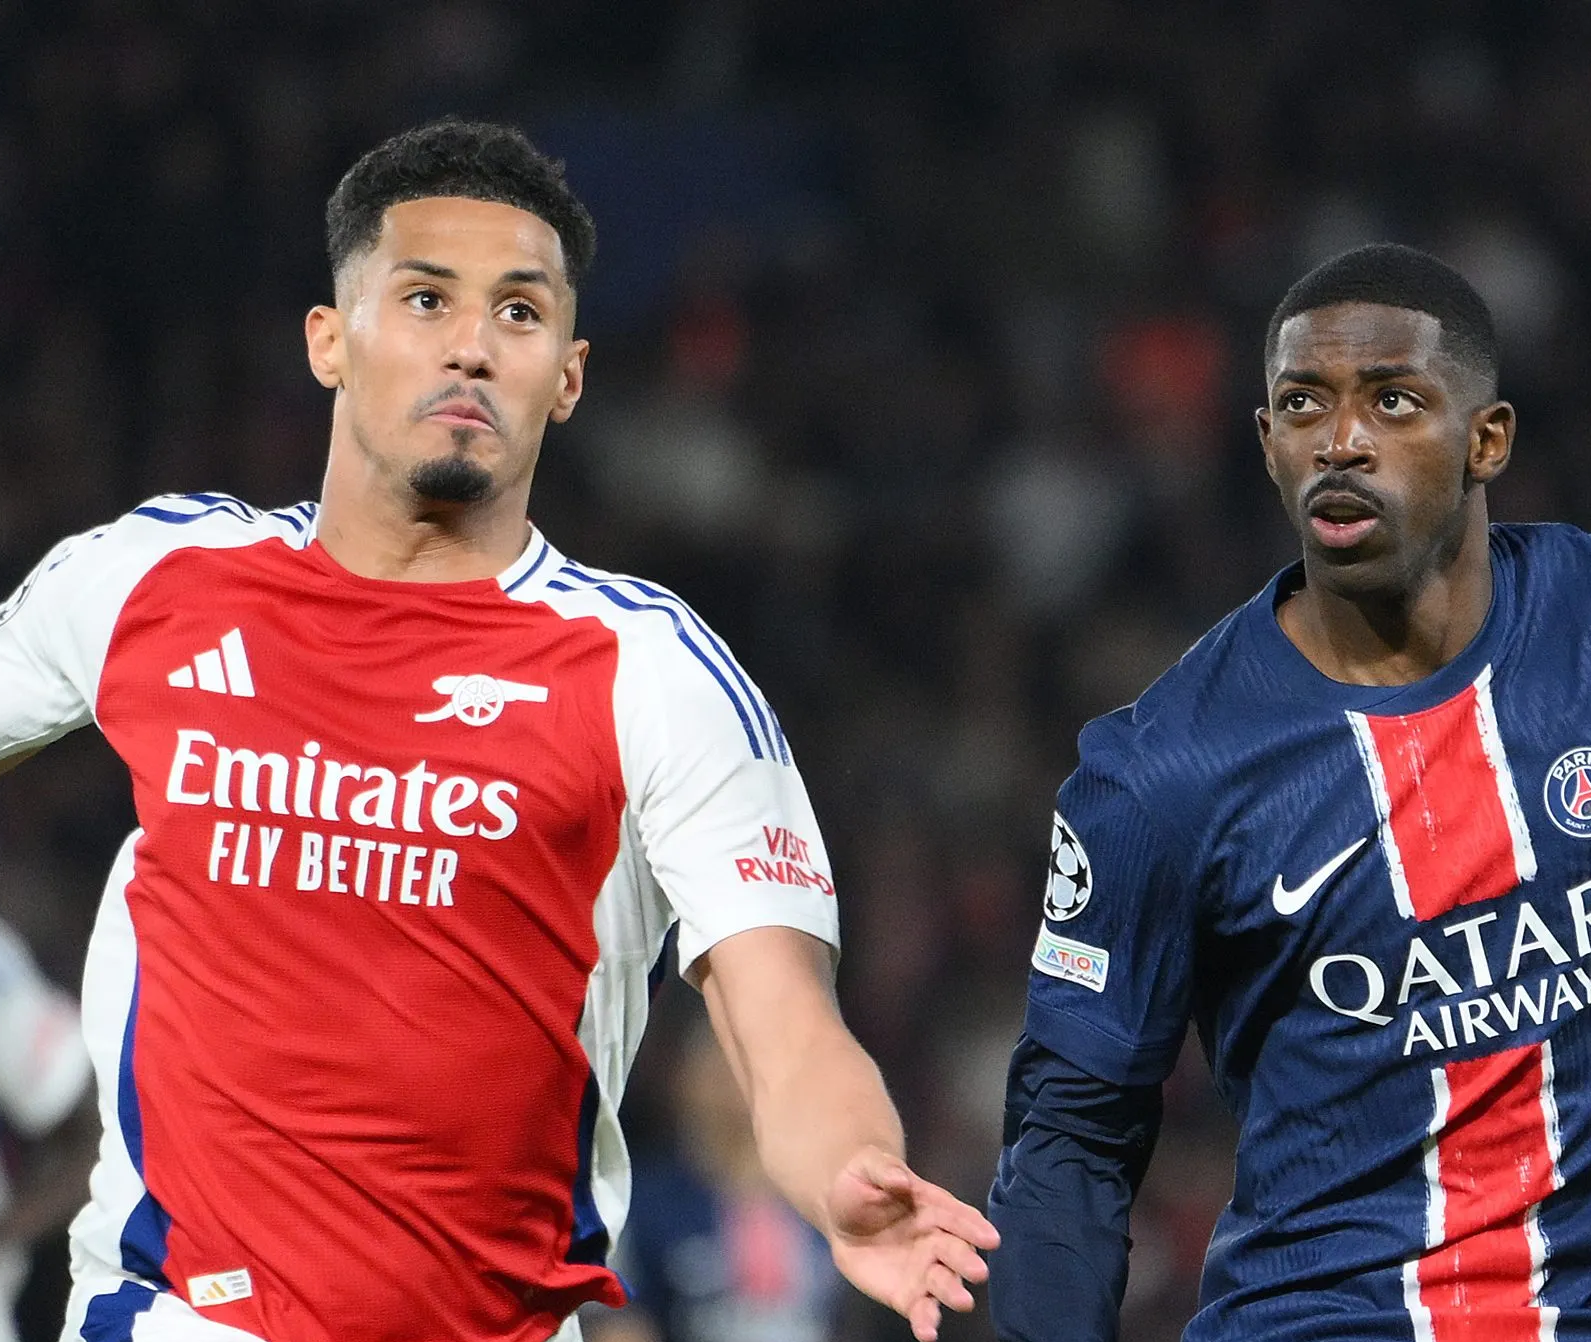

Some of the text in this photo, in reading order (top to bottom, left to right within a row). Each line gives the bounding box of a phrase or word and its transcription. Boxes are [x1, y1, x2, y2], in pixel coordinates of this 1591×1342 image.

[166, 729, 519, 840] Emirates
[208, 821, 459, 907] FLY BETTER
